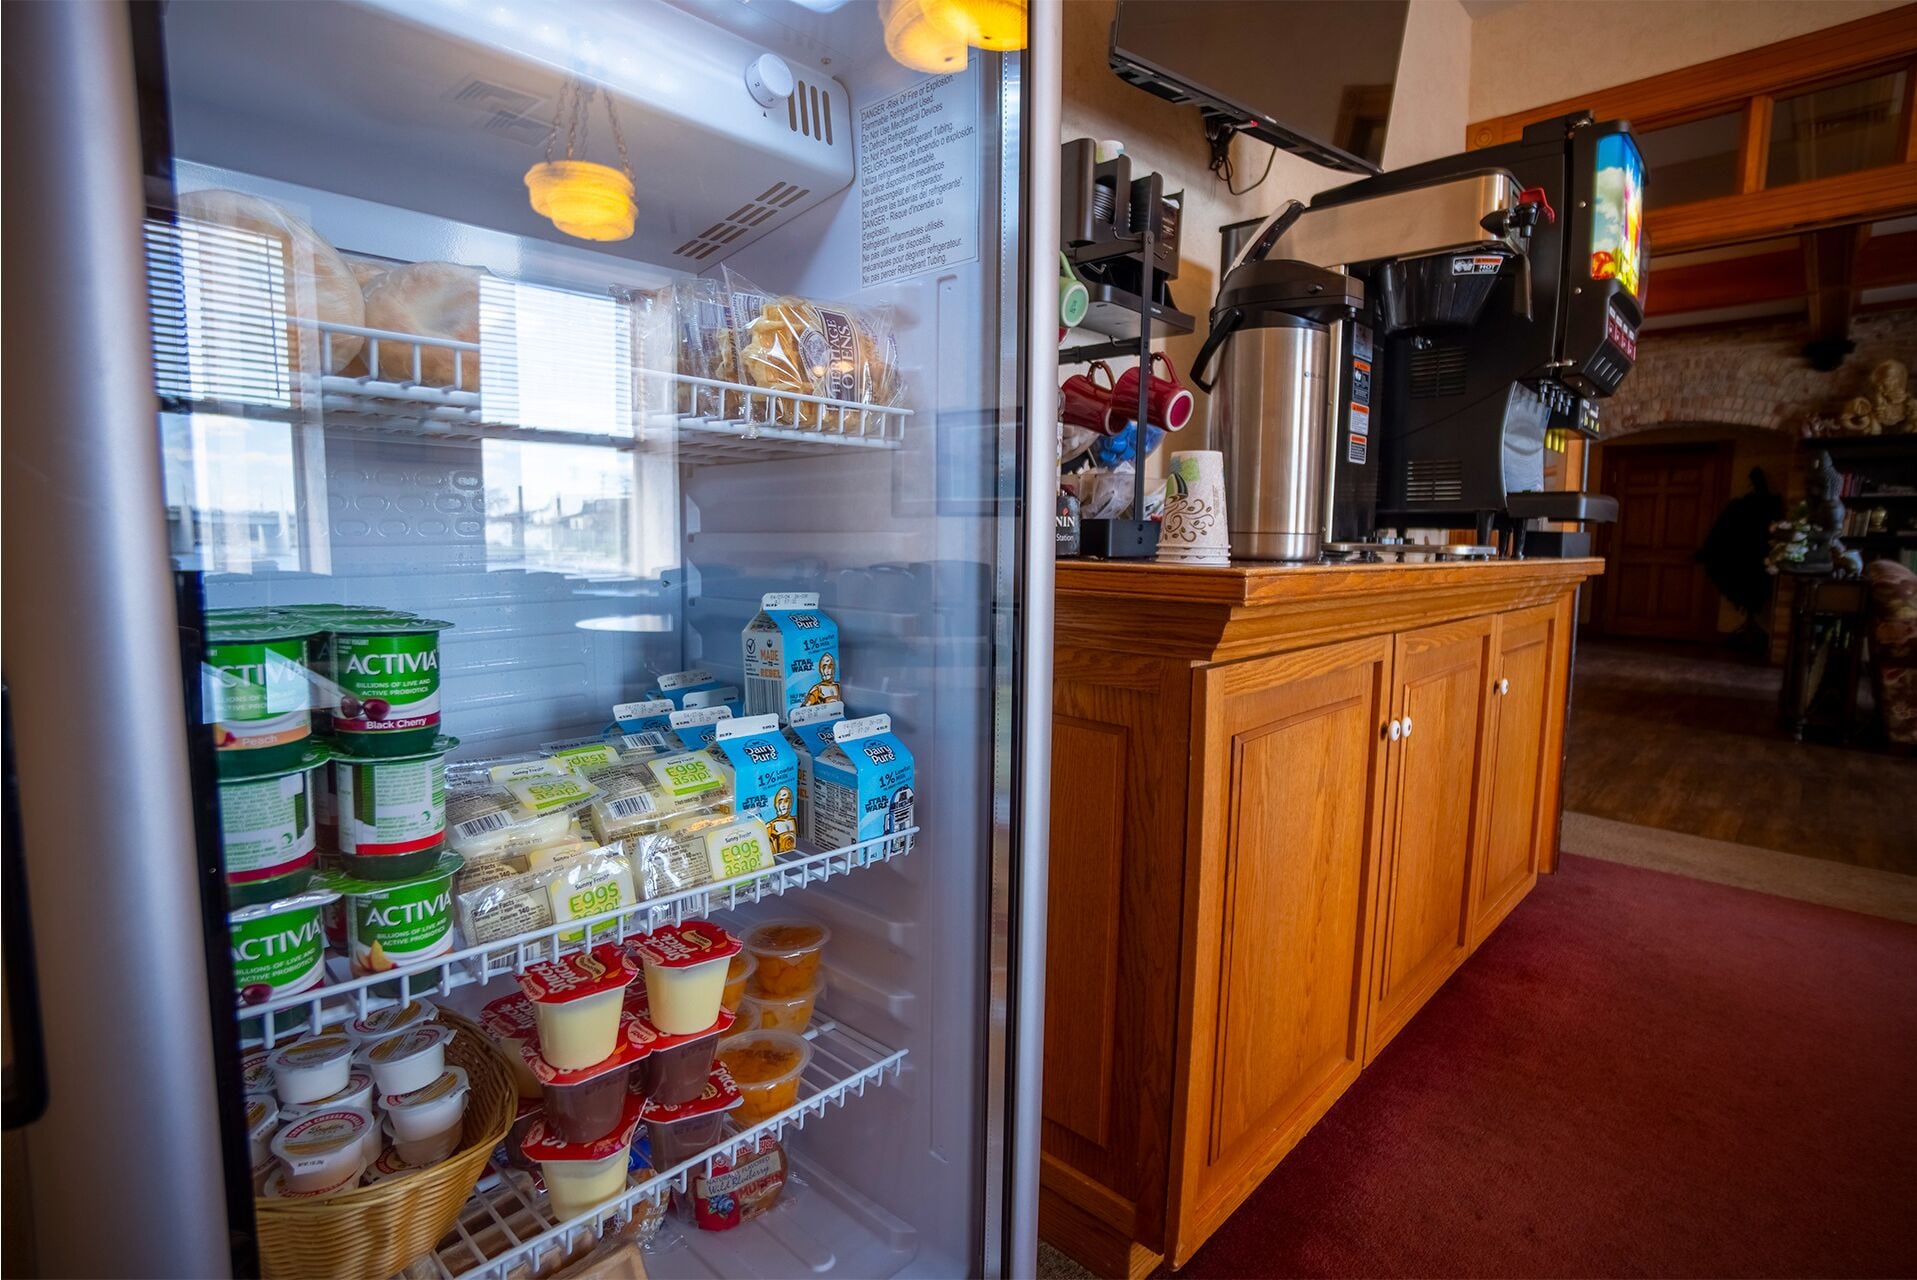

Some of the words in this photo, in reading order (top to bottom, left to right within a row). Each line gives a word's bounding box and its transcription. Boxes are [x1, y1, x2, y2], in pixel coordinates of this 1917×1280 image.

[862, 103, 885, 122] DANGER
[907, 90, 918, 101] Fire
[889, 100, 918, 120] Refrigerant
[891, 111, 920, 132] Mechanical
[921, 104, 943, 119] Devices
[903, 128, 932, 149] Refrigerant
[862, 214, 886, 230] DANGER
[890, 209, 907, 221] Risque
[827, 320, 840, 393] HERITAGE
[790, 614, 816, 622] Dairy
[796, 620, 820, 630] Pure
[804, 638, 819, 651] 1%
[760, 650, 778, 660] MADE
[346, 652, 437, 675] ACTIVIA
[791, 664, 814, 672] WARS
[761, 668, 780, 678] REBEL
[390, 687, 428, 695] PROBIOTICS
[366, 720, 395, 729] Black
[396, 717, 427, 729] Cherry
[242, 735, 277, 746] Peach
[744, 744, 776, 756] Dairy
[864, 744, 893, 756] Dairy
[751, 752, 777, 764] Pure
[872, 754, 896, 765] Pure
[665, 761, 706, 777] Eggs
[672, 769, 711, 786] asap!
[758, 770, 775, 787] 1%
[880, 772, 895, 788] 1%
[742, 801, 769, 810] WARS
[746, 794, 768, 803] STAR
[867, 796, 888, 804] STAR
[865, 802, 889, 813] WARS
[721, 839, 759, 864] Eggs
[481, 863, 496, 871] Facts
[724, 855, 761, 876] asap!
[575, 880, 592, 890] Sunny
[570, 882, 618, 913] Eggs
[366, 890, 451, 926] ACTIVIA
[500, 913, 518, 921] Calories
[377, 931, 409, 939] BILLIONS
[422, 924, 436, 932] LIVE
[410, 926, 445, 941] PROBIOTICS
[287, 955, 302, 965] LIVE
[240, 973, 270, 982] ACTIVE
[272, 957, 313, 976] PROBIOTICS
[706, 1170, 740, 1185] NATURALLY
[742, 1156, 770, 1172] FLAVORED
[708, 1180, 730, 1194] Wild
[732, 1166, 769, 1186] Blueberry
[737, 1172, 784, 1198] MUFFIN
